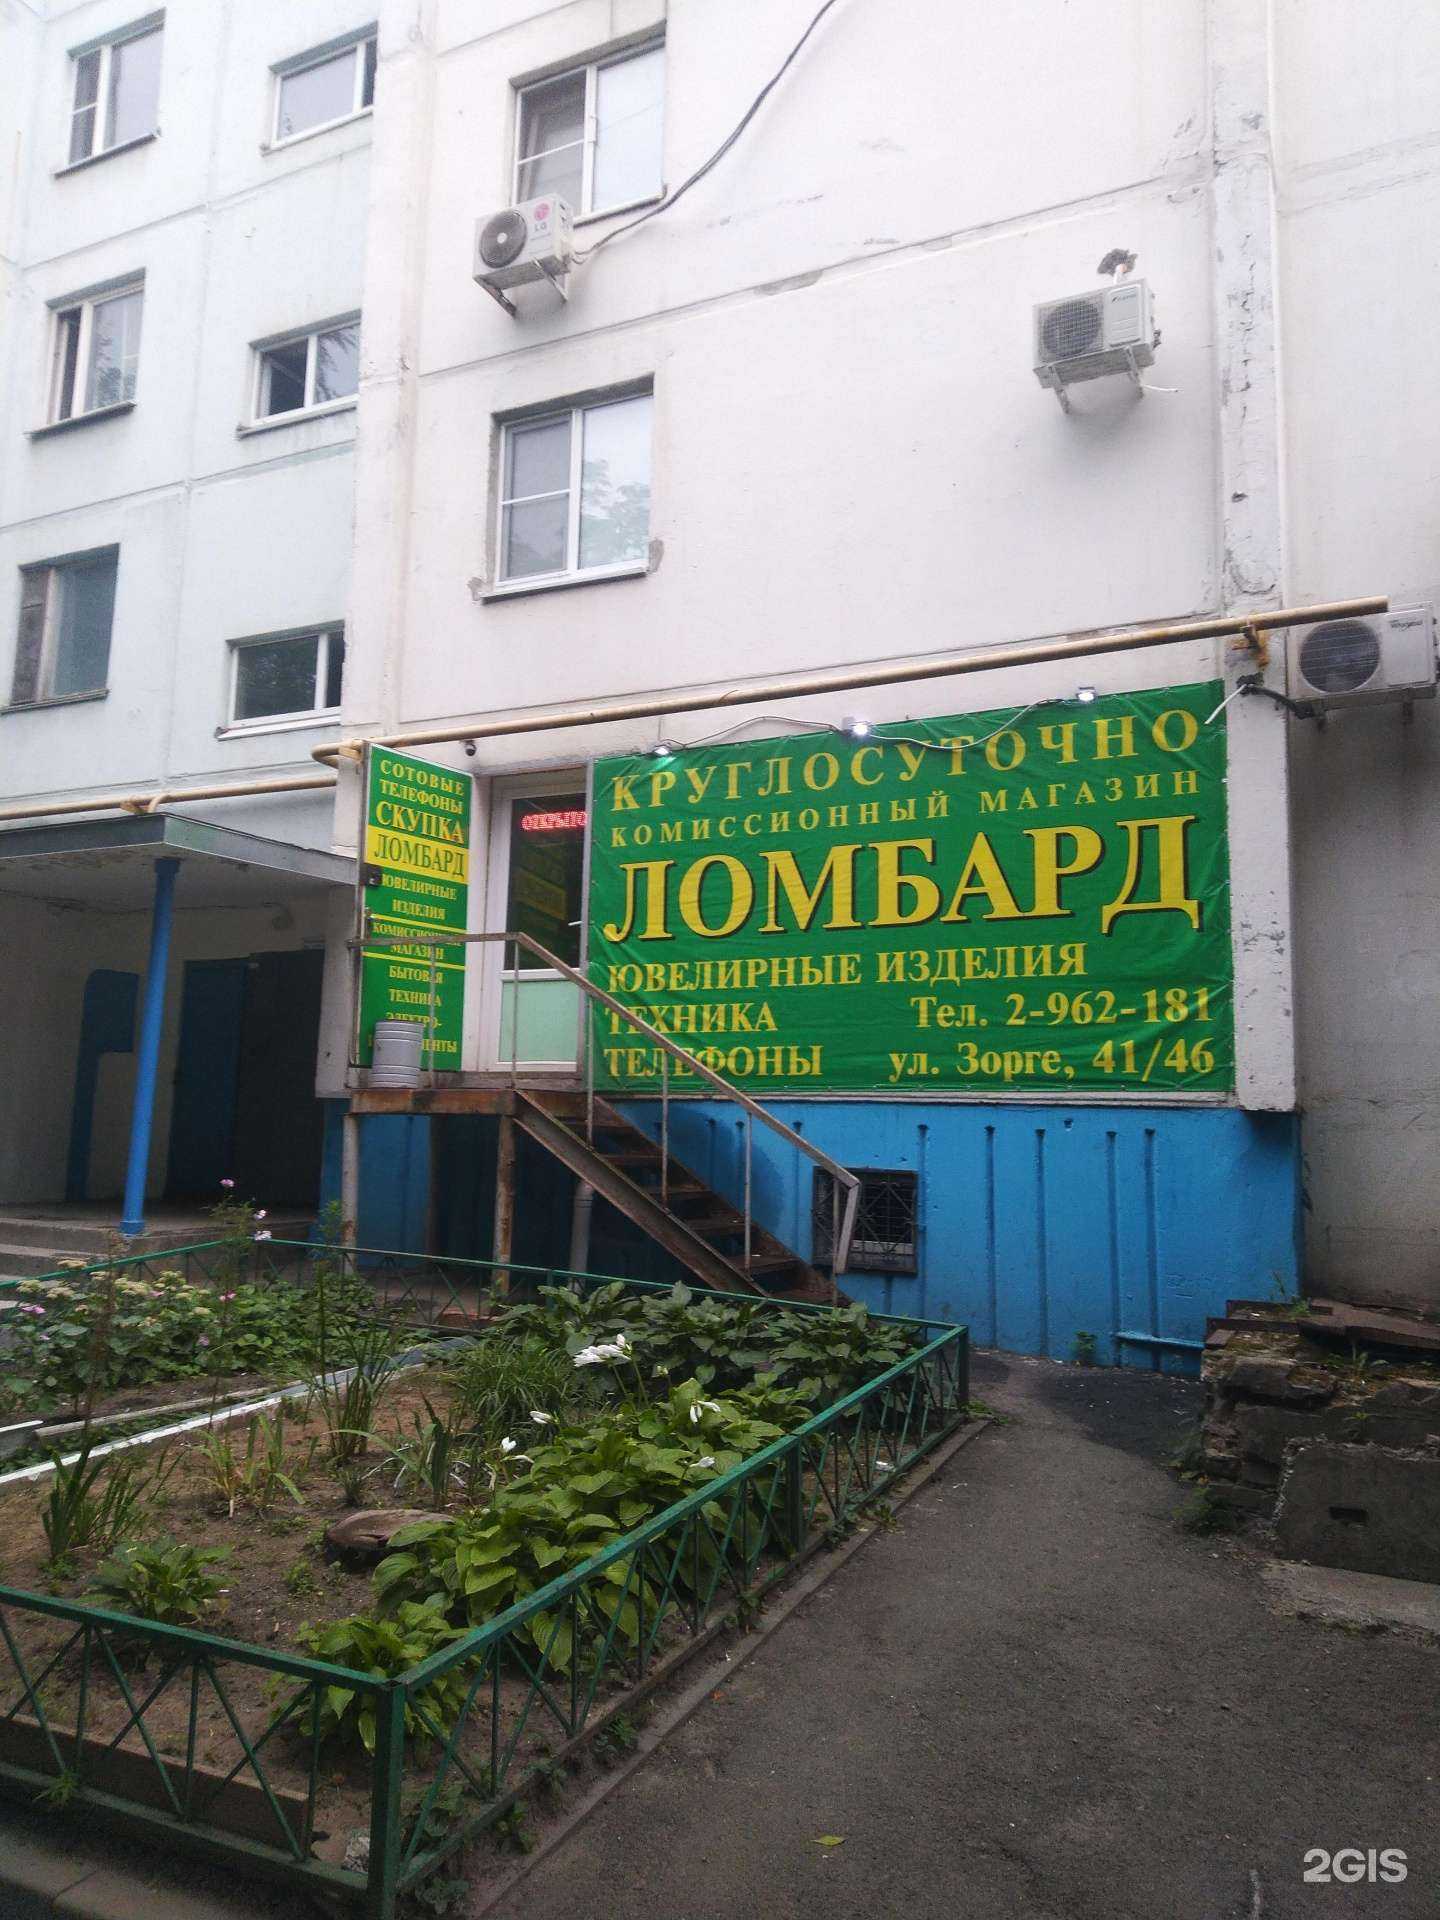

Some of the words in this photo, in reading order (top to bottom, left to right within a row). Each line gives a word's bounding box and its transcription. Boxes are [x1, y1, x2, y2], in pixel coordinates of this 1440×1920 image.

[380, 759, 465, 796] СОТОВЫЕ
[610, 709, 1199, 812] КРУГЛОСУТОЧНО
[379, 778, 464, 815] ТЕЛЕФОНЫ
[610, 790, 950, 848] КОМИССИОННЫЙ
[979, 769, 1200, 814] МАГАЗИН
[375, 800, 465, 845] СКУПКА
[374, 833, 465, 877] ЛОМБАРД
[381, 873, 457, 900] ЮВЕЛИРНЫЕ
[602, 815, 1201, 943] ЛОМБАРД
[392, 899, 446, 920] ИЗДЕЛИЯ
[389, 966, 444, 984] БЫТОВЯ
[607, 953, 862, 993] ЮВЕЛИРНЫЕ
[875, 943, 1089, 987] ИЗДЕЛИЯ
[604, 1002, 778, 1035] ТЕХНИКА
[910, 996, 989, 1028] Тел.
[1005, 987, 1216, 1027] 2-962-181
[604, 1045, 824, 1078] ТЕЛЕФОНЫ
[888, 1051, 940, 1083] ул.
[956, 1042, 1076, 1082] Зорге,
[1092, 1037, 1215, 1082] 41/46
